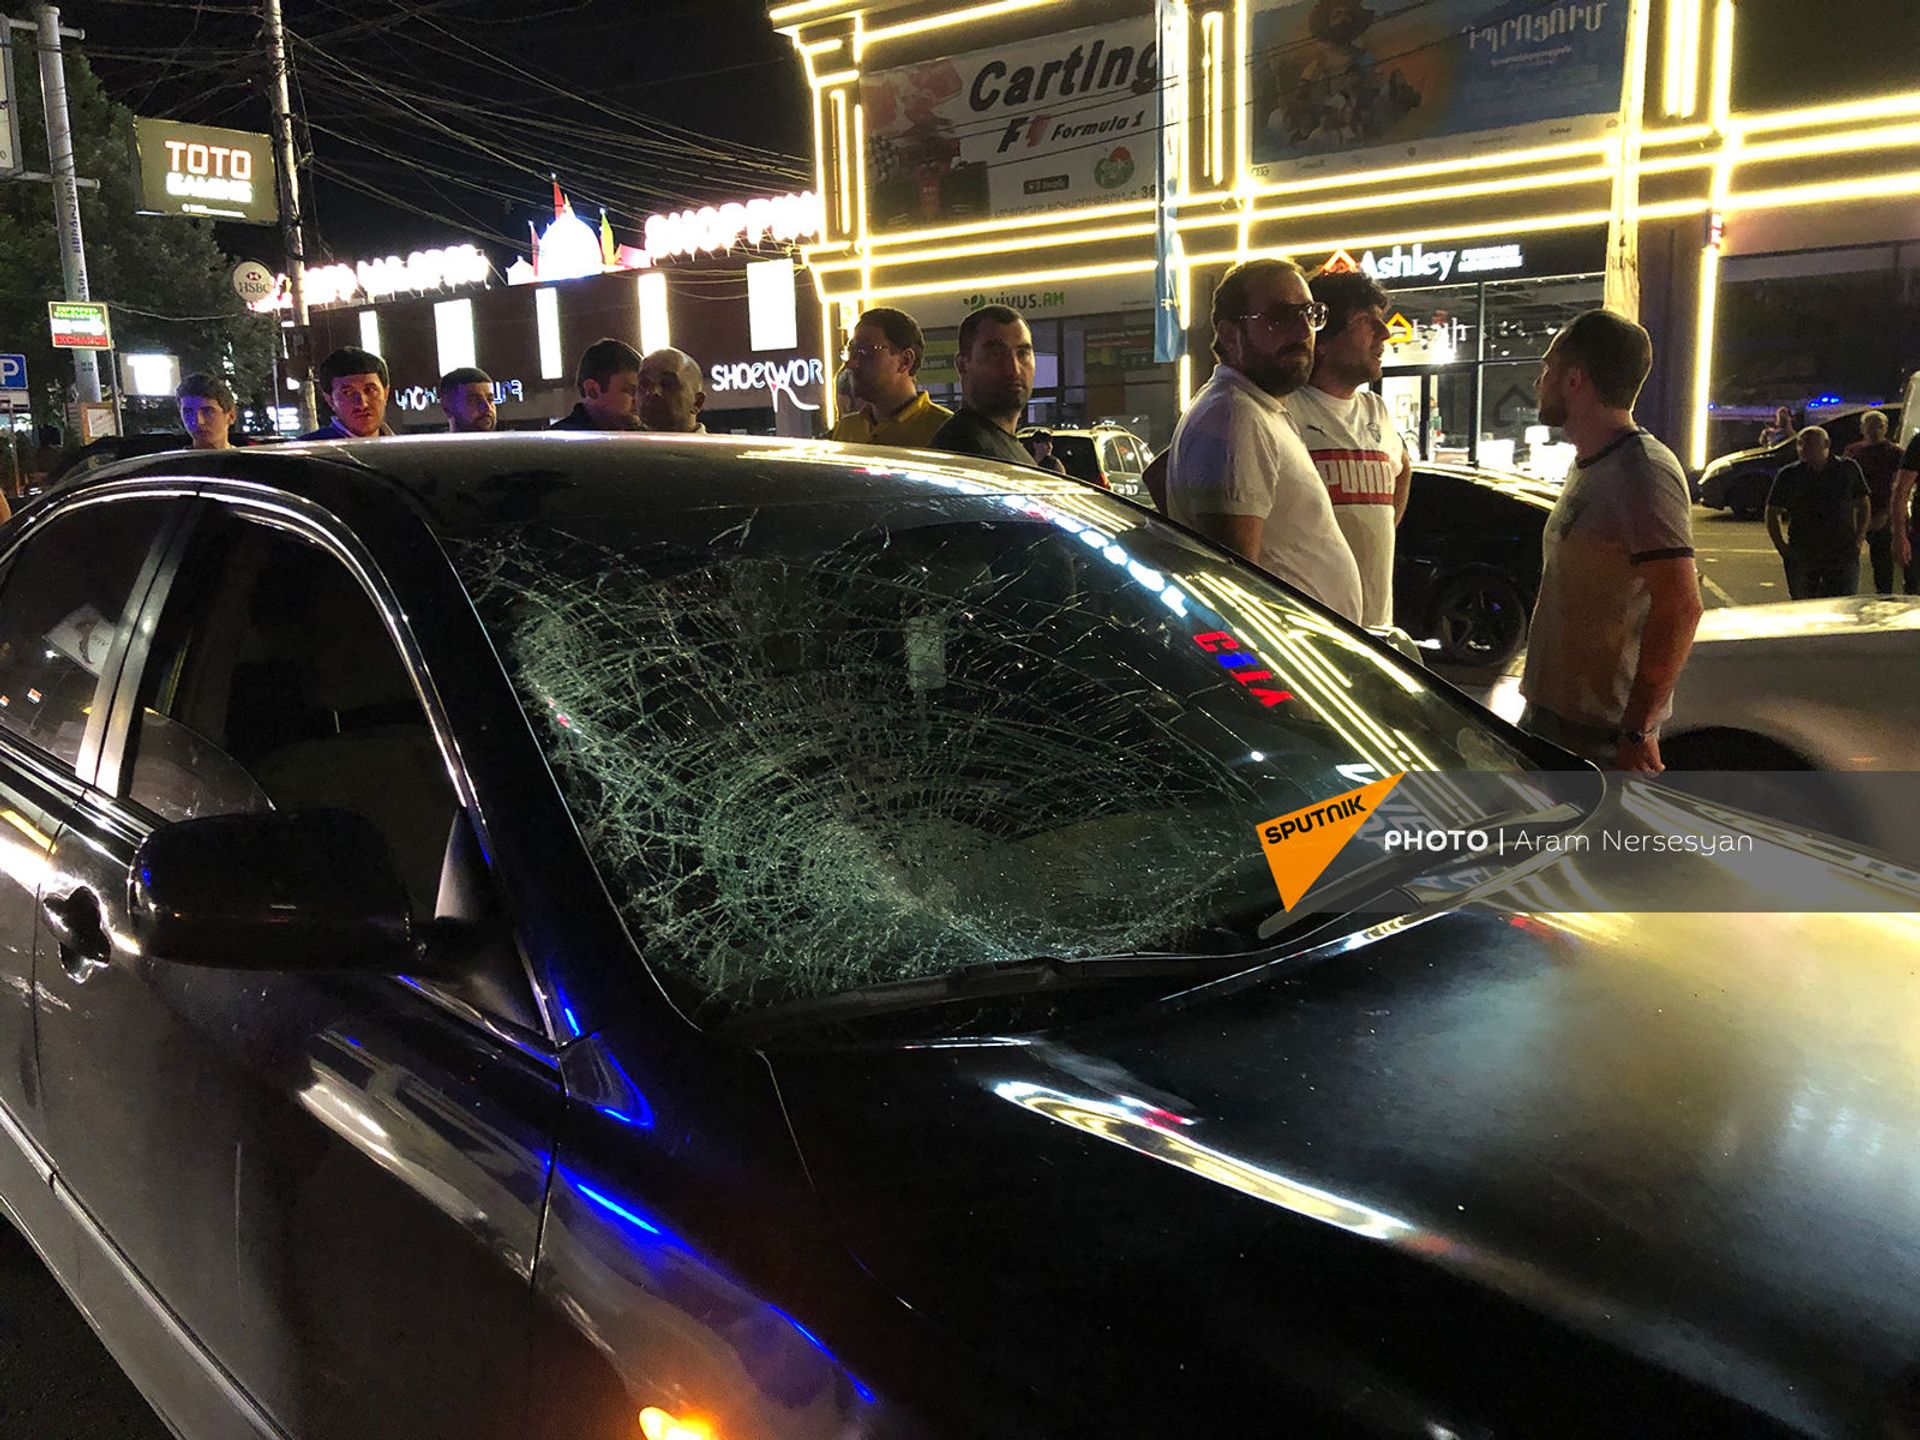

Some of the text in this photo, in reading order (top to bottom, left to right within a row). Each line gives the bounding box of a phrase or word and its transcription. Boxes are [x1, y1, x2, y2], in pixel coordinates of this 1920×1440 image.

[1051, 116, 1129, 141] Formula
[1131, 110, 1145, 128] 1
[165, 140, 252, 180] TOTO
[1360, 243, 1457, 282] Ashley
[238, 281, 270, 294] HSBC
[0, 359, 20, 385] P
[1315, 459, 1396, 495] PUMA
